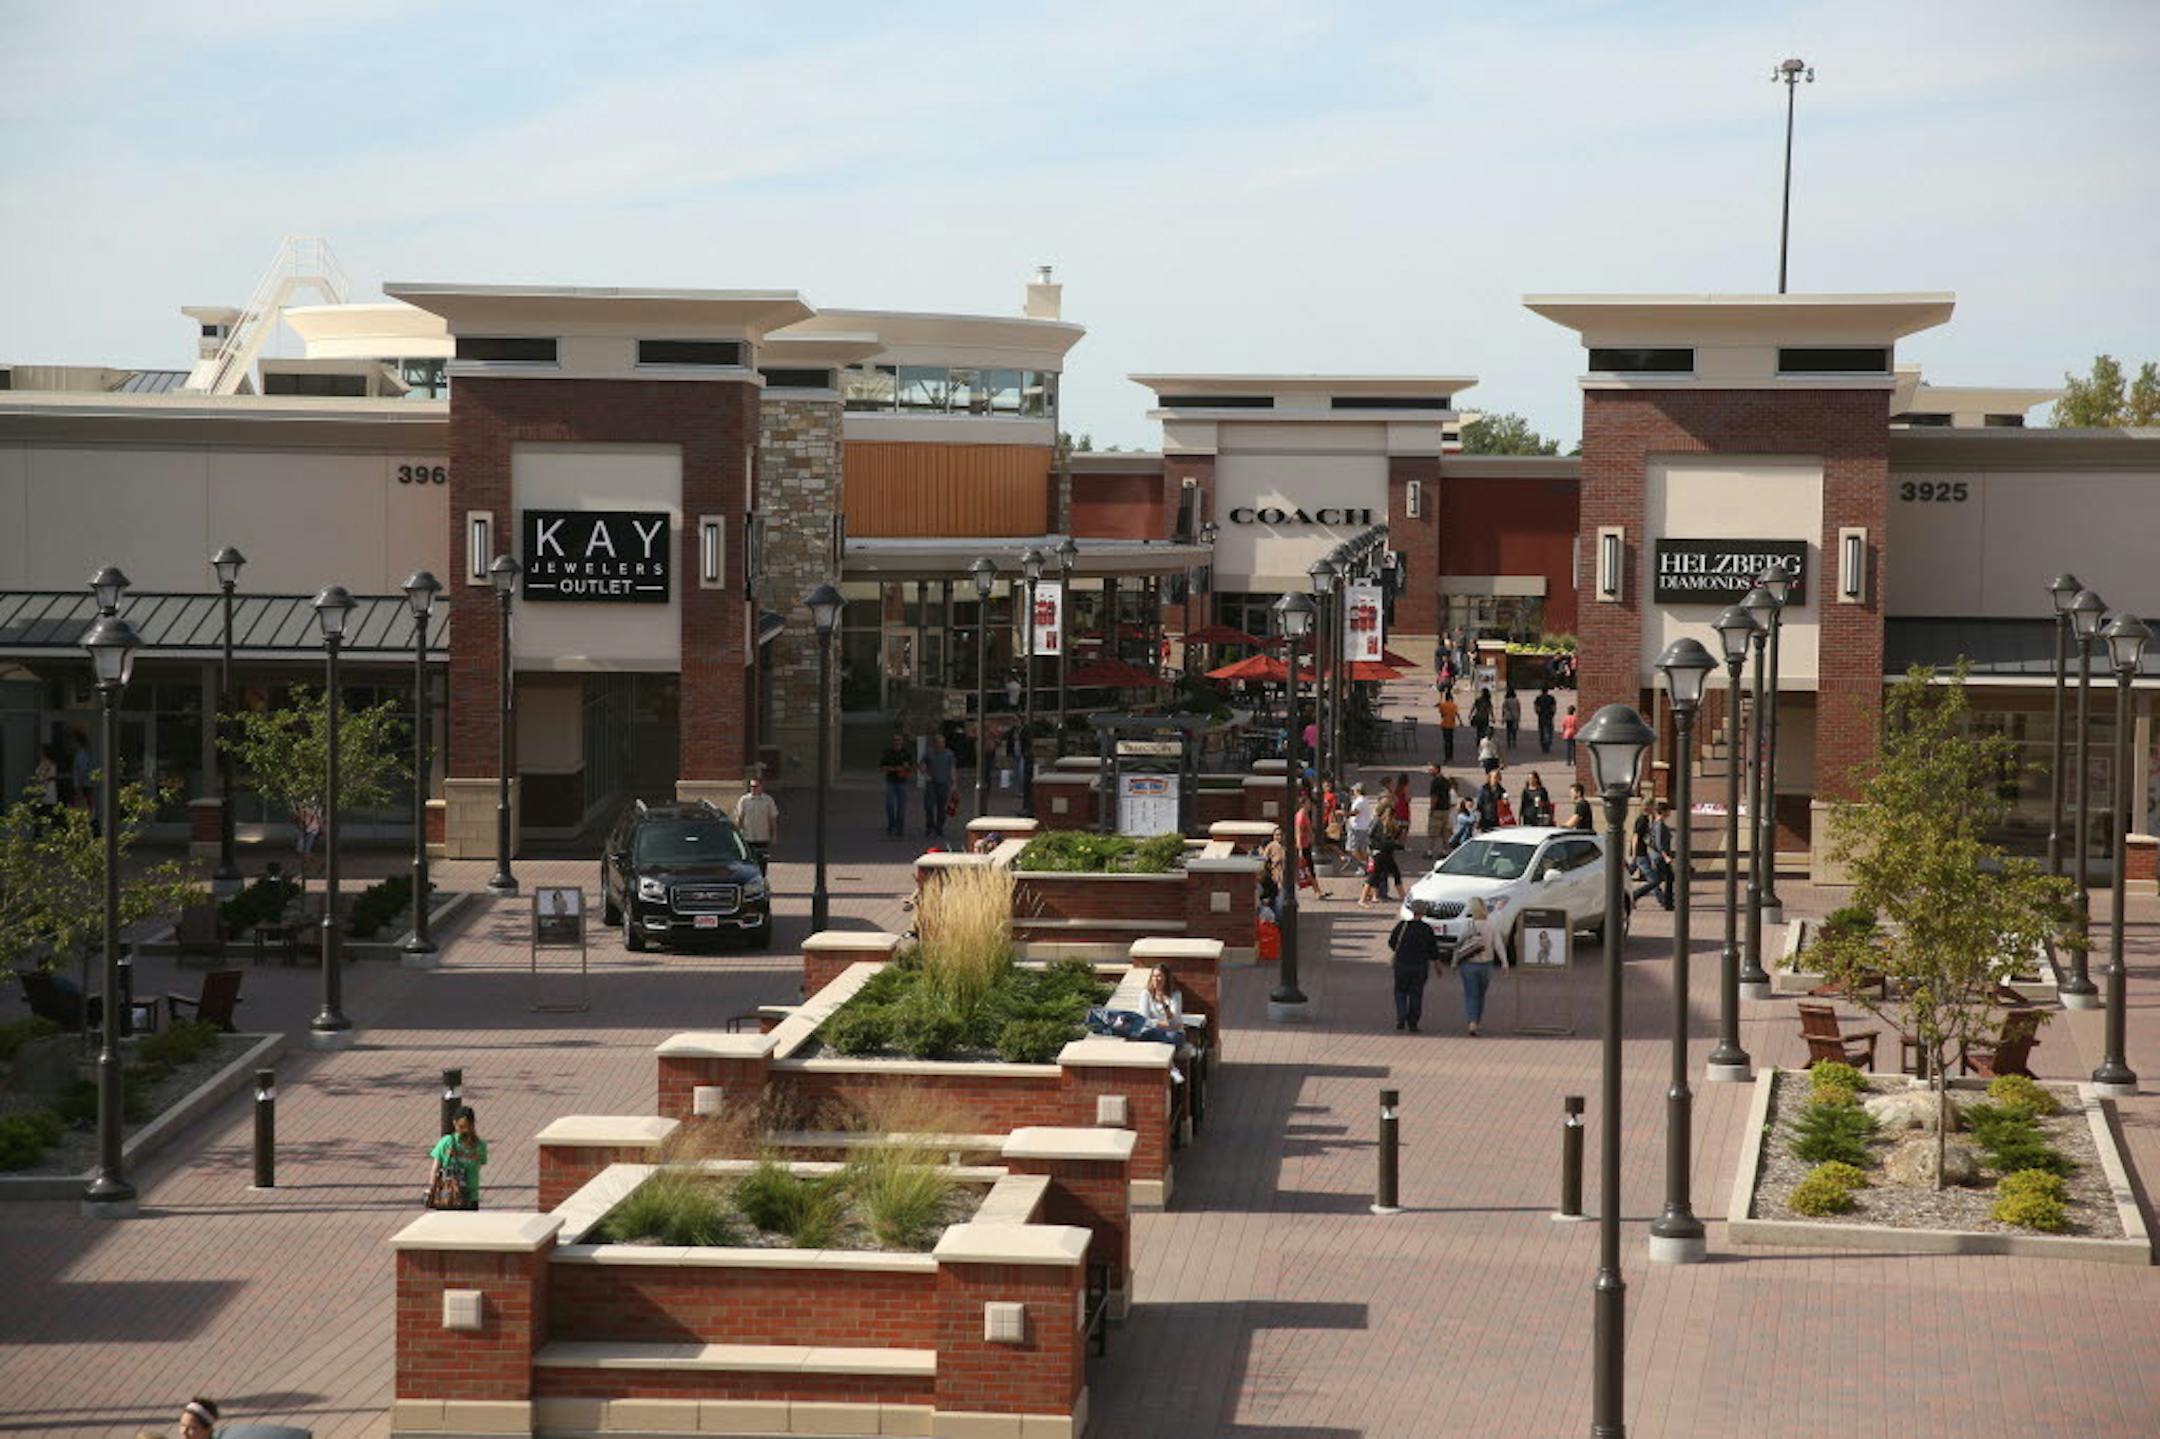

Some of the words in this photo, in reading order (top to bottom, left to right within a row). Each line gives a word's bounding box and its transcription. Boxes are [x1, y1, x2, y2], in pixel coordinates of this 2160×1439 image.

[398, 465, 446, 485] 396
[1899, 482, 1969, 503] 3925
[1229, 507, 1373, 526] COACH
[535, 517, 664, 559] KAY
[530, 561, 665, 577] JEWELERS
[560, 578, 633, 595] OUTLET
[1658, 575, 1751, 590] DIAMONDS
